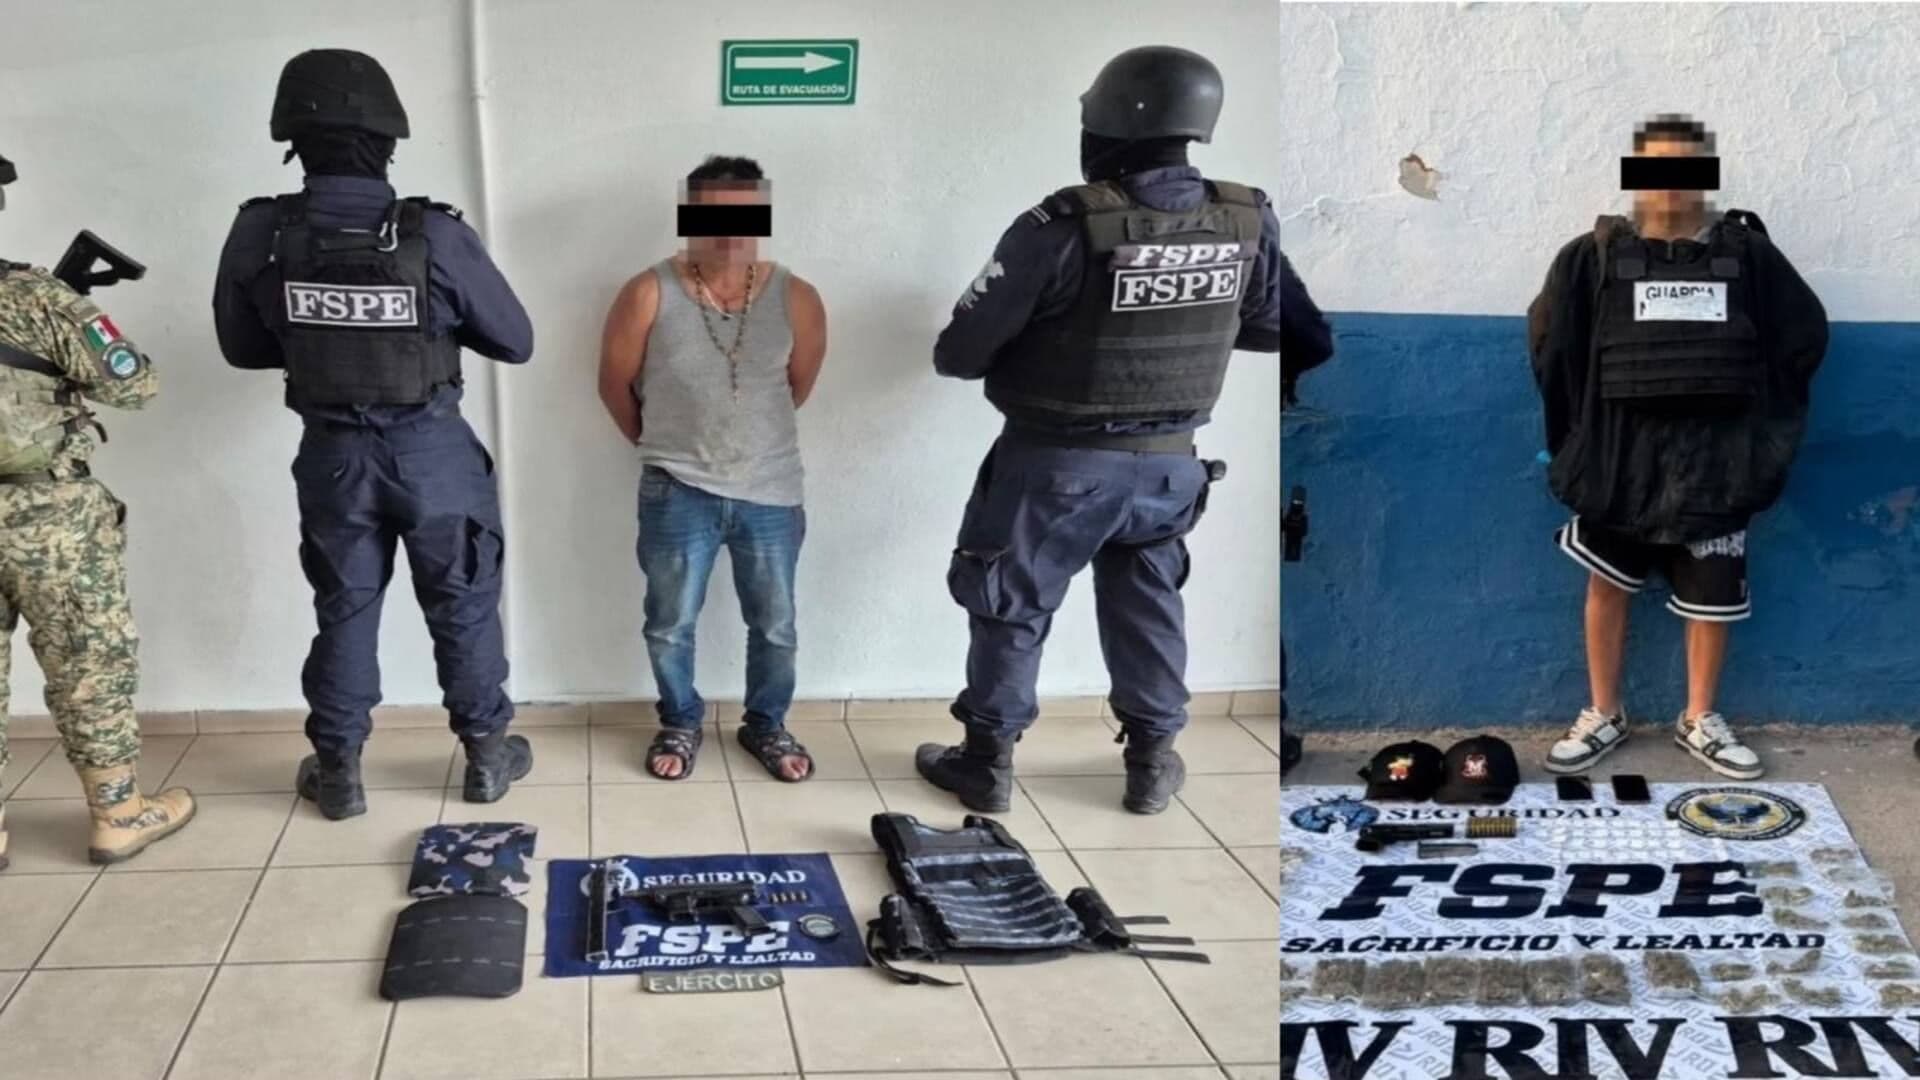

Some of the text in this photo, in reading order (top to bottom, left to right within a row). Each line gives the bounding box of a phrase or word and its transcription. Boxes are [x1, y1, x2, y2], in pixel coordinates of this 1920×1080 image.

[732, 85, 760, 95] RUTA
[763, 85, 777, 95] DE
[1119, 268, 1236, 305] FSPE
[291, 288, 410, 320] FSPE
[1386, 807, 1621, 820] SEGURIDAD
[1317, 860, 1764, 920] FSPE
[614, 920, 791, 956] FSPE
[1281, 933, 1825, 953] SACRIFICIO Y LEALTAD
[598, 952, 816, 969] SACRIFICIO Y LEALTAD
[1444, 1018, 1686, 1080] RIV
